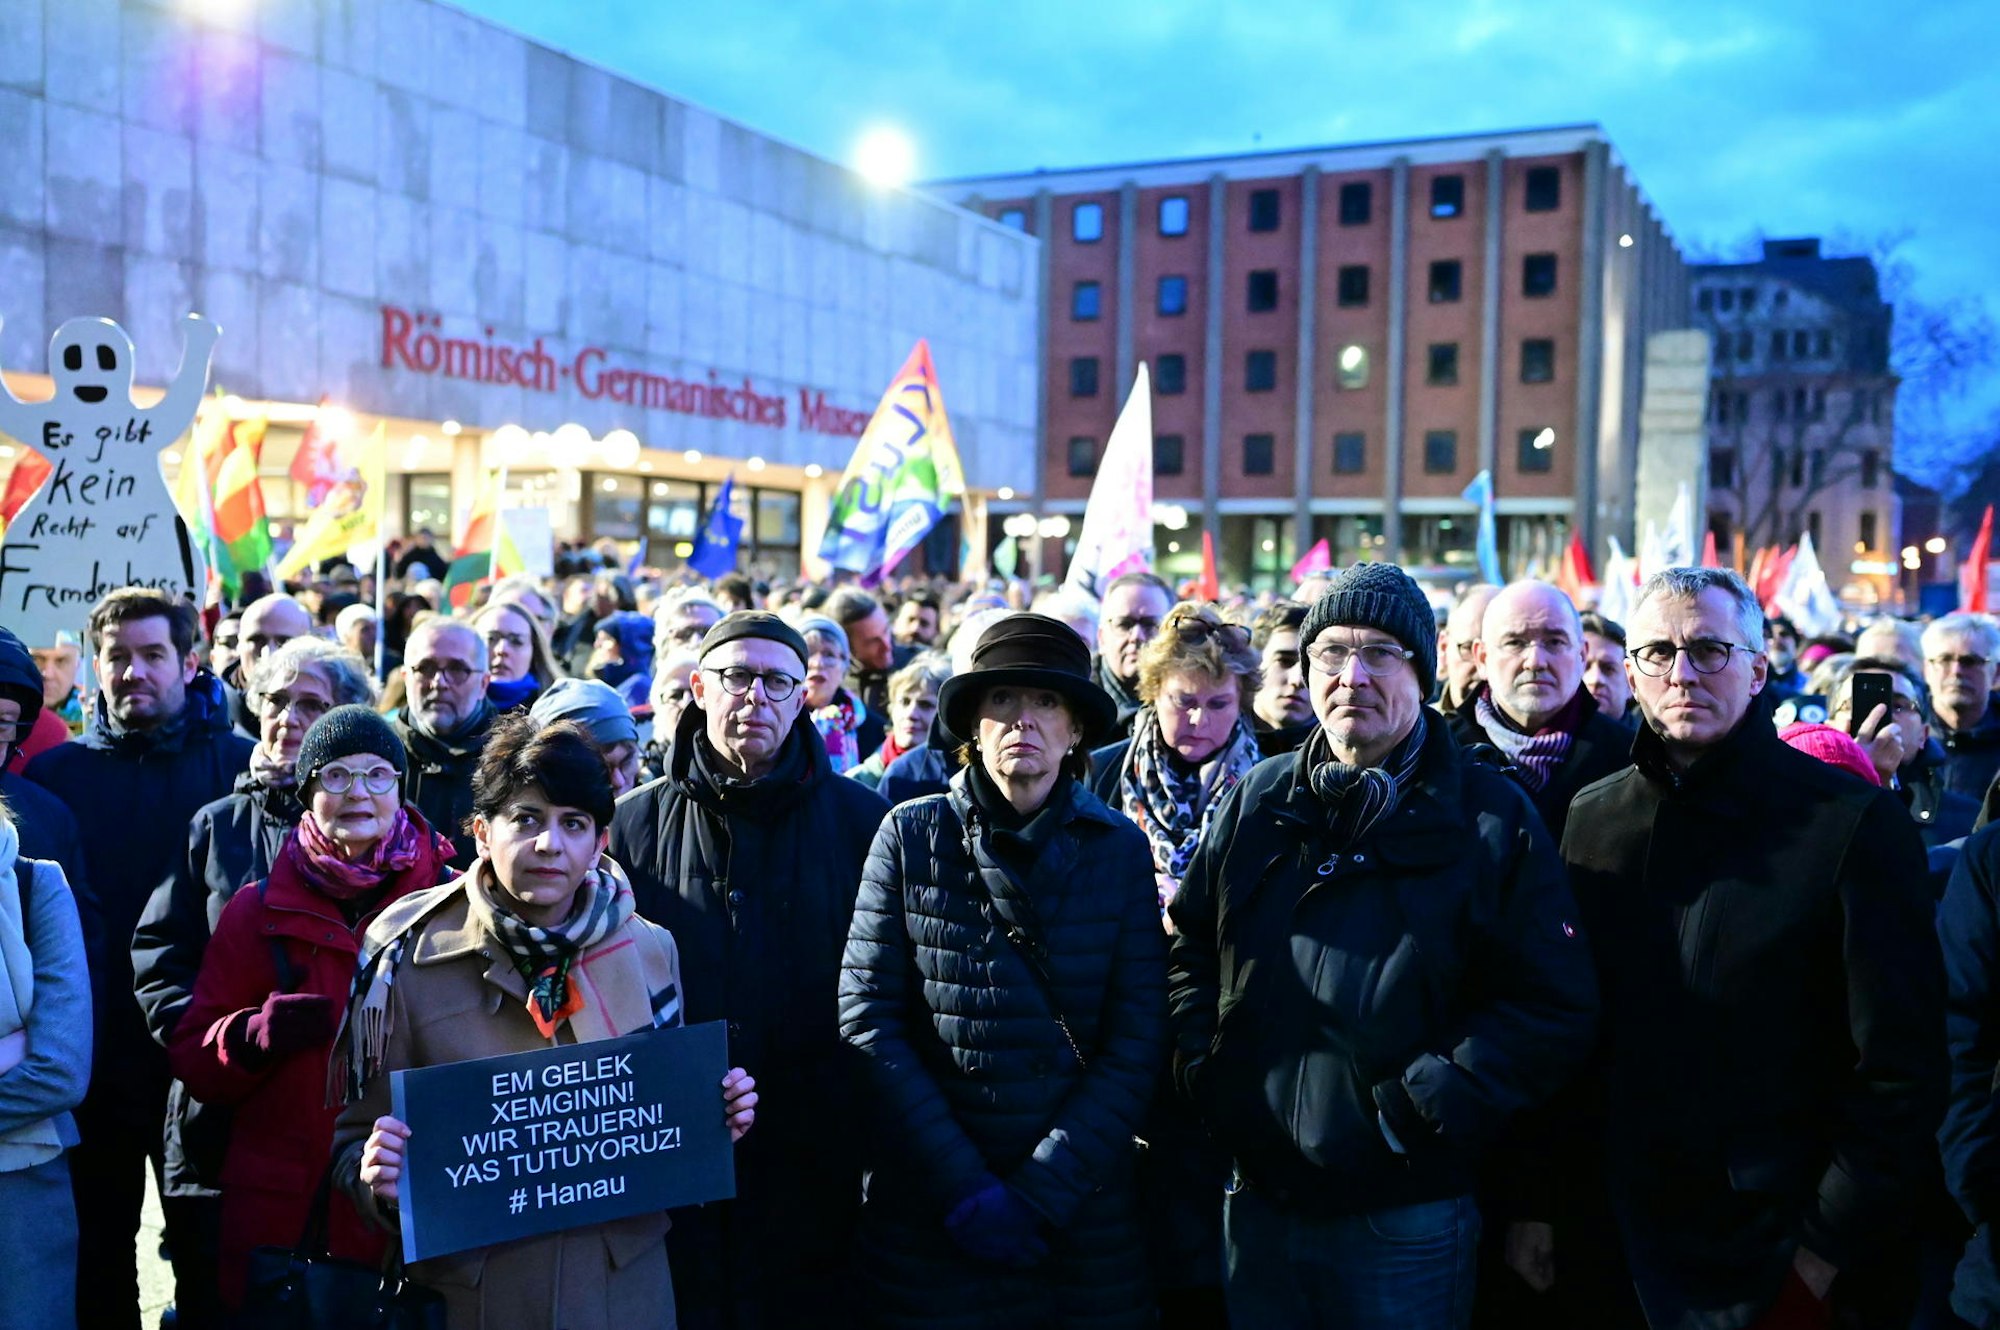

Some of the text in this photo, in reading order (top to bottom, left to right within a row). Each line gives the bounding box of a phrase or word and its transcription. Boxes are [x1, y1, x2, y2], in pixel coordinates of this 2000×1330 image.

[799, 387, 874, 437] Muse
[43, 417, 153, 463] Es gibt
[30, 512, 158, 543] Recht auf
[492, 1053, 633, 1097] EM GELEK
[491, 1081, 634, 1125] XEMGININ!
[462, 1103, 663, 1157] WIR TRAUERN!
[445, 1126, 681, 1188] YAS TUTUYORUZ!
[536, 1175, 625, 1209] Hanau
